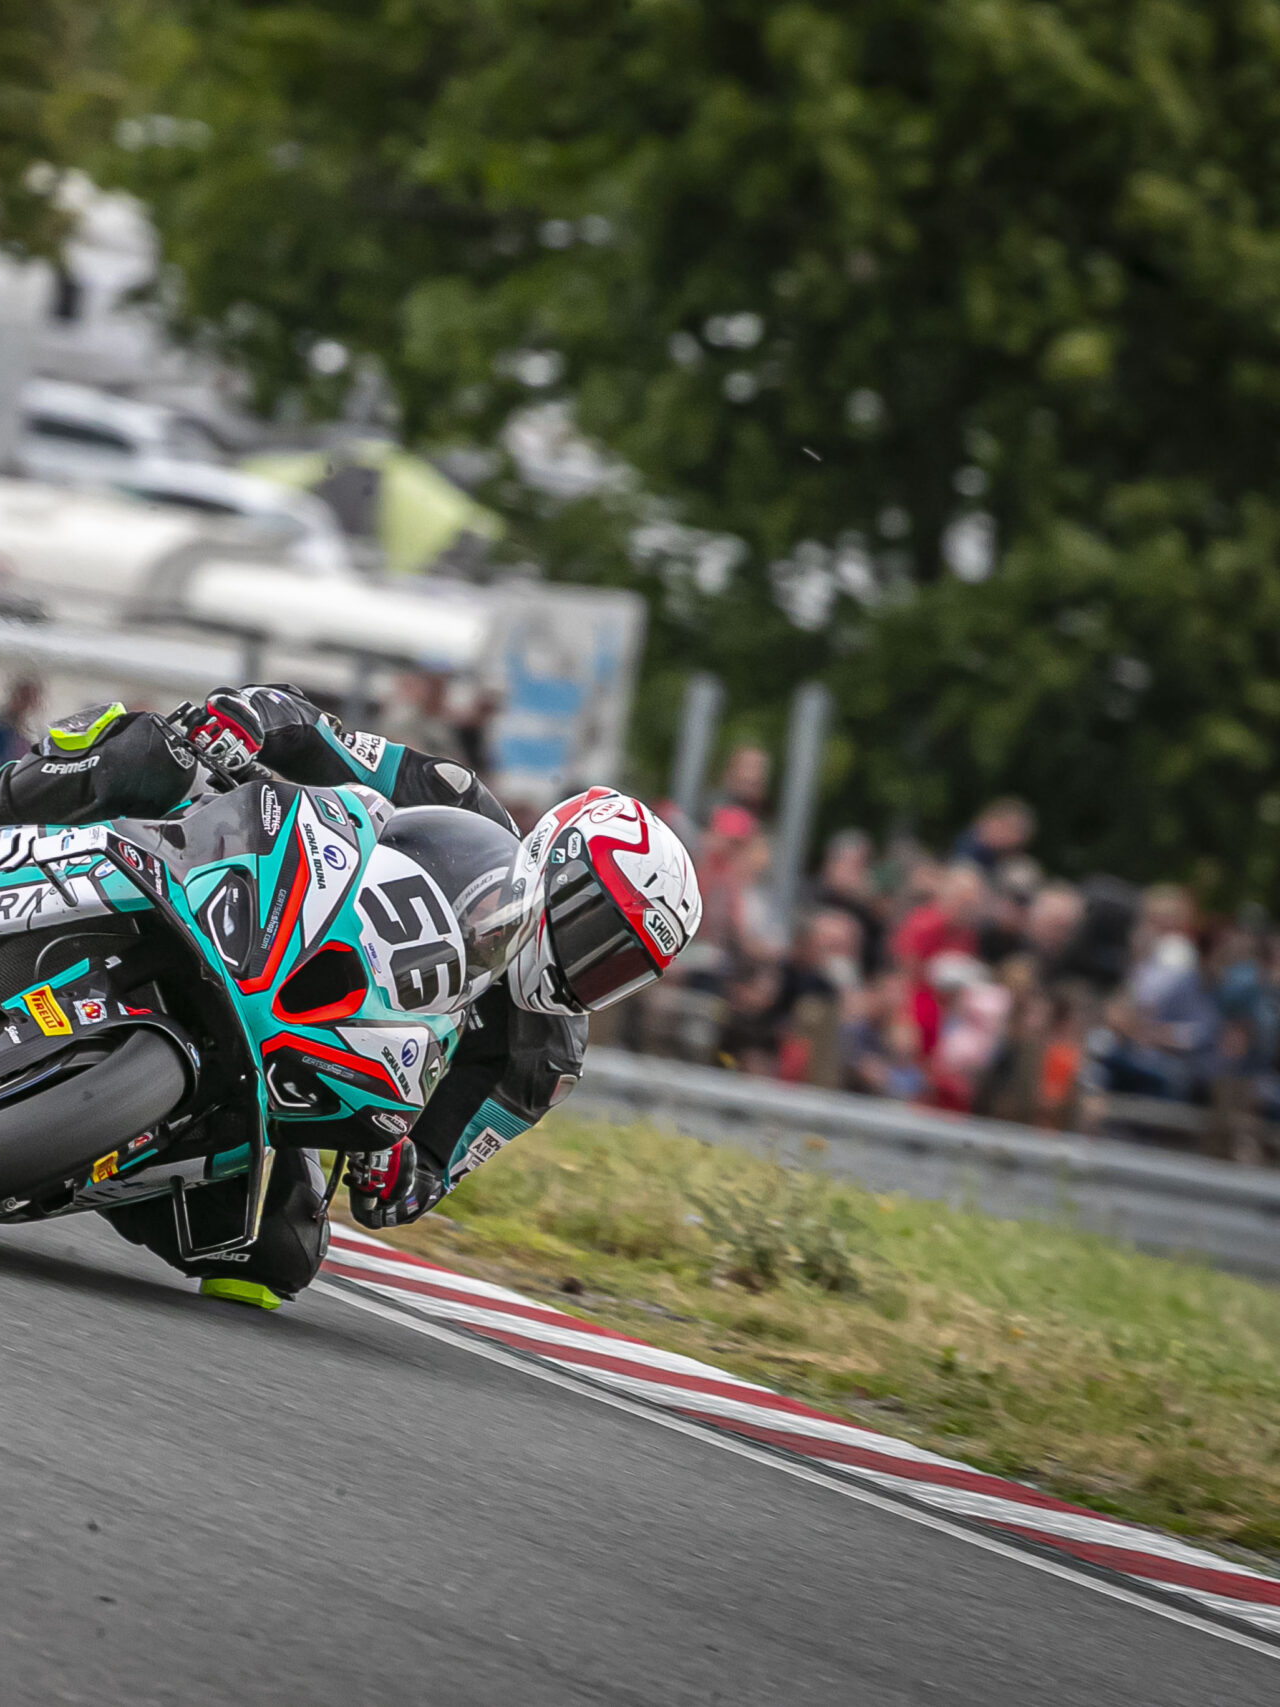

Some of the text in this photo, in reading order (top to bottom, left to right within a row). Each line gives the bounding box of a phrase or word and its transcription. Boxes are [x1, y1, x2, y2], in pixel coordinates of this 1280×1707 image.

[41, 755, 101, 774] DAMEN
[303, 823, 326, 890] SIGNAL IDUNA
[359, 874, 461, 1011] 56
[648, 913, 676, 952] SHOEI
[29, 990, 65, 1030] PIRELLI
[381, 1046, 401, 1076] SIGNAL
